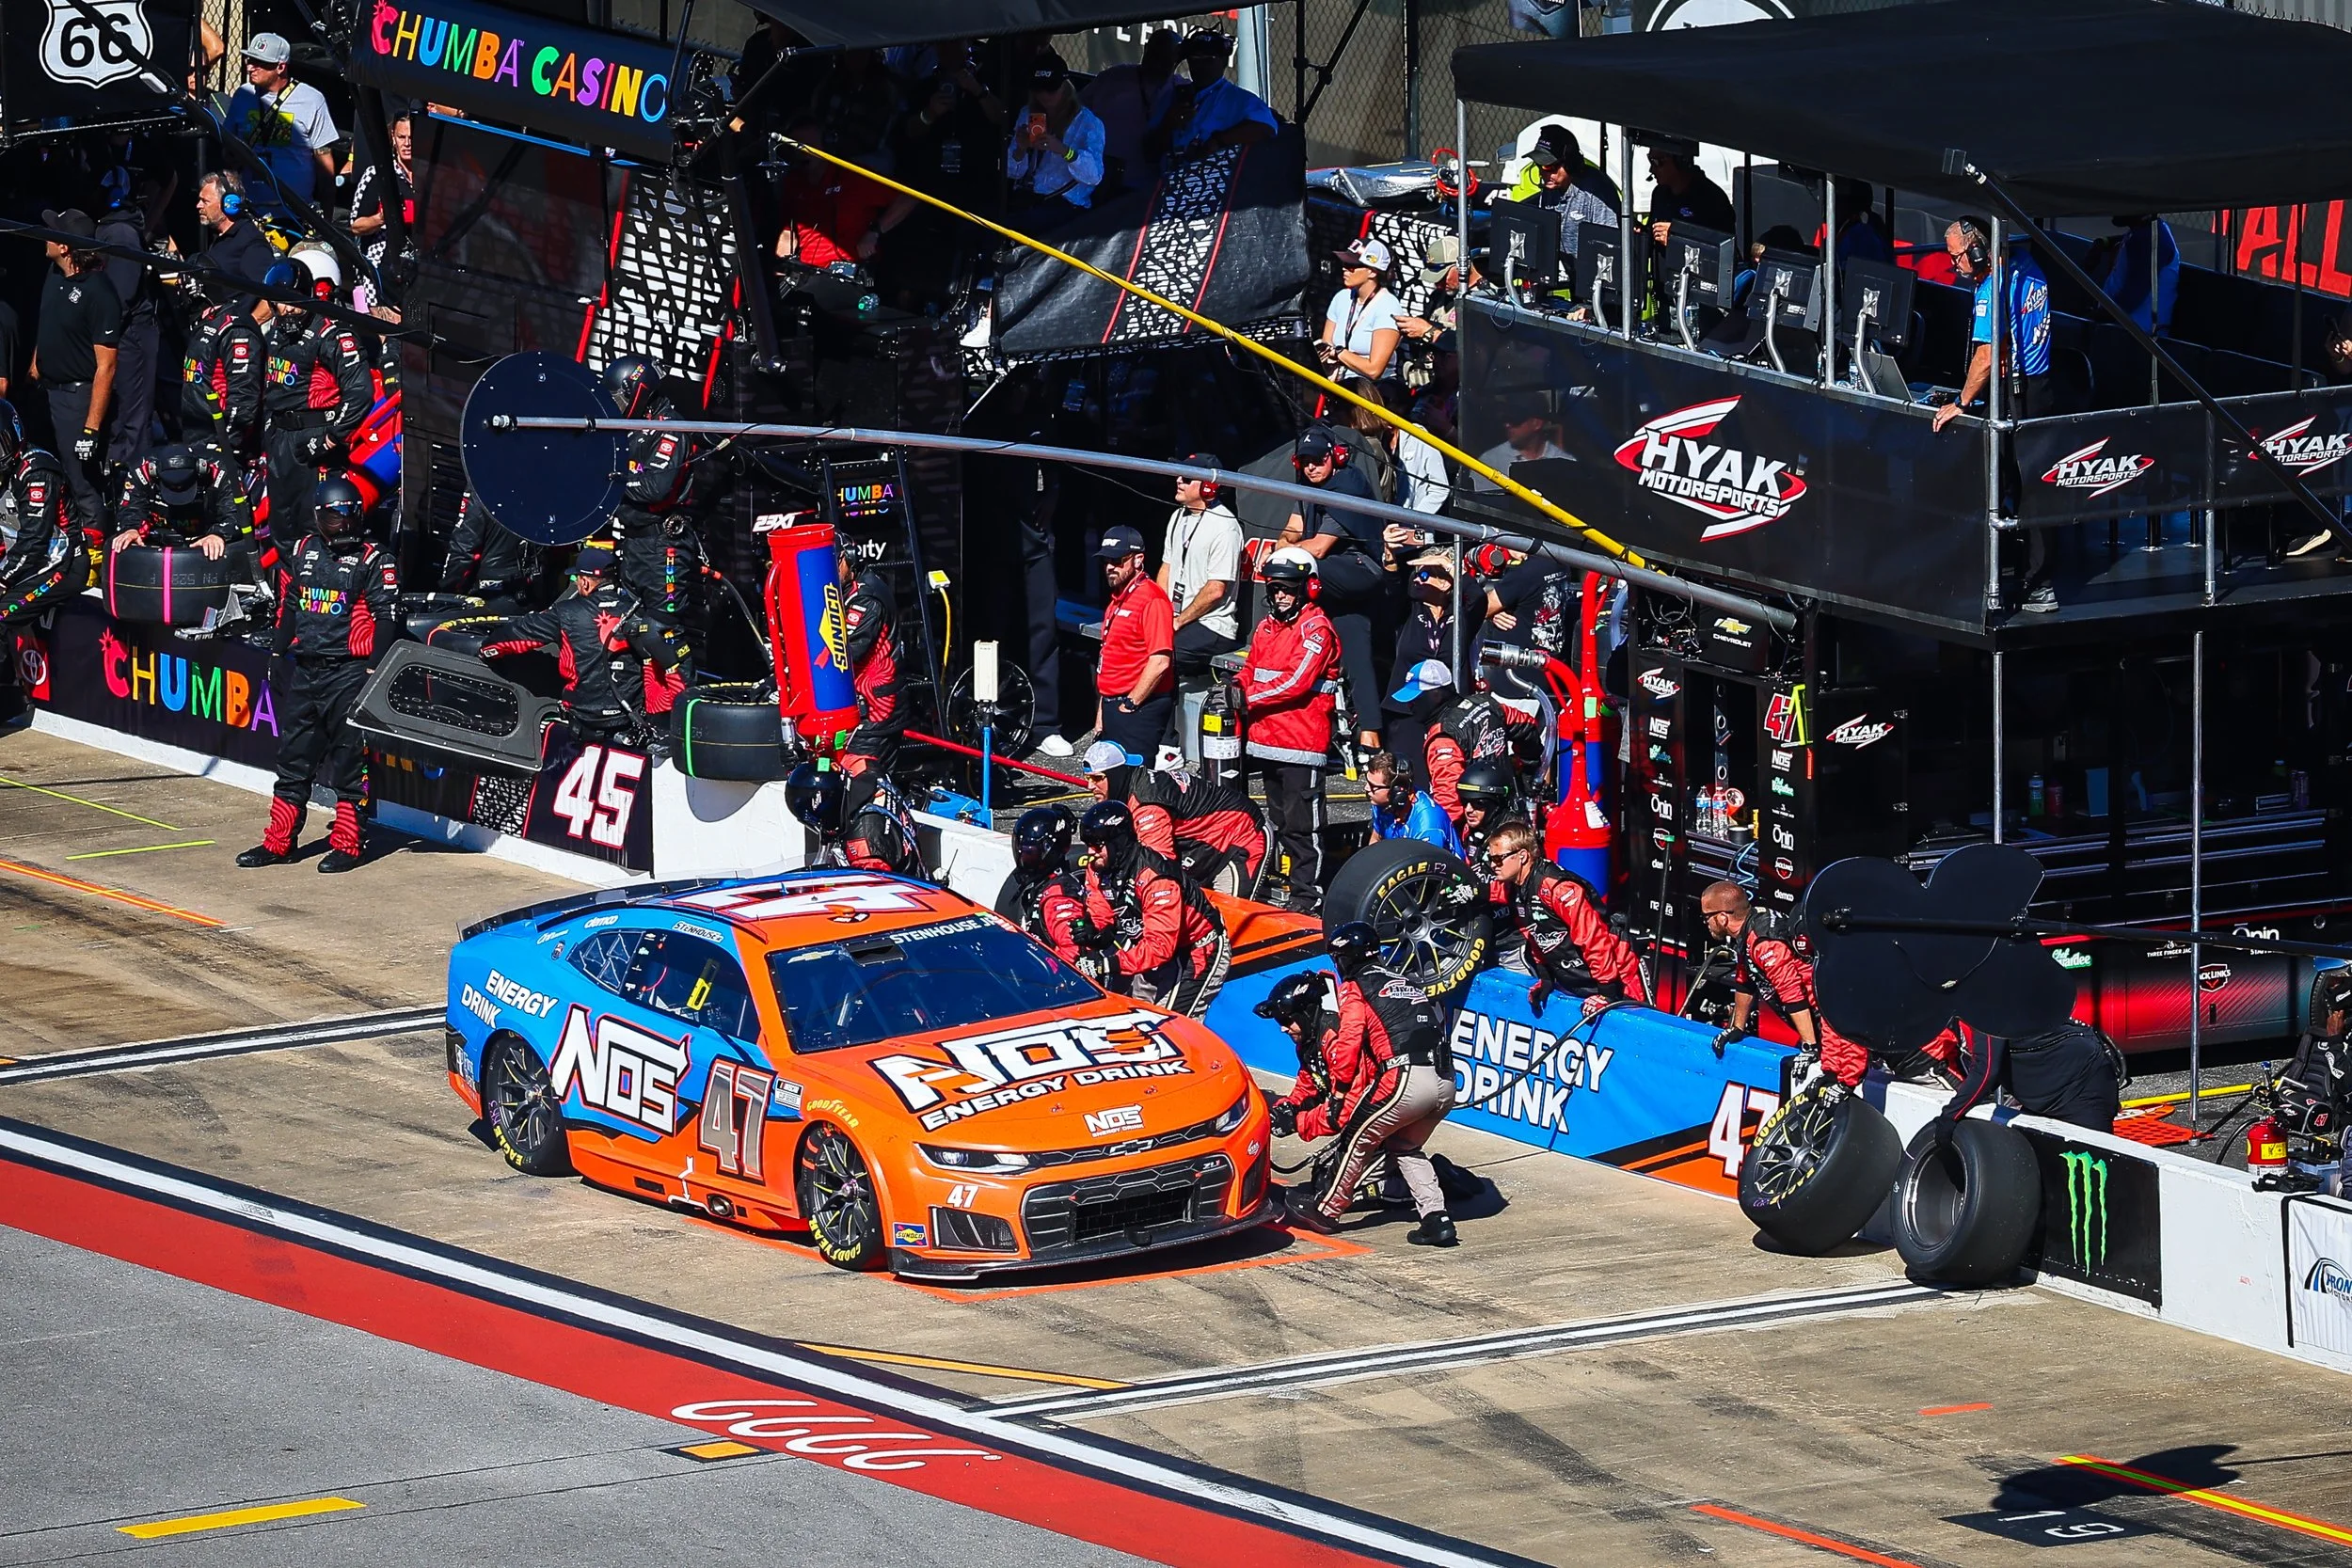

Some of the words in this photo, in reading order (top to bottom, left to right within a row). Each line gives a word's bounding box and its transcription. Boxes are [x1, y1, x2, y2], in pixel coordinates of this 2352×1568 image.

[532, 46, 667, 122] CASINO
[2265, 433, 2351, 456] HYAK
[2275, 449, 2346, 462] TORSPORTS
[1641, 428, 1788, 496] HYAK
[2058, 453, 2141, 480] HYAK
[2057, 468, 2137, 487] MOTORSPORTS
[837, 483, 894, 502] HUMBA
[1638, 468, 1780, 518] MOTORSPORTS
[299, 585, 347, 604] HUMBA
[824, 583, 849, 672] SUNOCO
[1713, 633, 1752, 647] CHEVROLET
[99, 627, 278, 737] CHUMBA
[1644, 674, 1675, 689] HYAK
[1650, 717, 1670, 736] NOS
[1836, 722, 1884, 739] HYAK
[1772, 750, 1793, 768] NOS
[553, 744, 645, 849] 45
[1377, 861, 1428, 899] EAGLE
[1774, 889, 1795, 902] demco
[584, 915, 618, 929] demco
[890, 917, 981, 944] STENHOUSE
[2051, 948, 2069, 959] Chef
[2147, 949, 2163, 958] THREE
[2164, 948, 2182, 958] FINGER
[2183, 947, 2192, 956] JAC
[1426, 937, 1486, 998] GOODYE
[461, 983, 502, 1029] DRINK
[485, 968, 559, 1020] ENERGY
[870, 1008, 1176, 1113] NOS
[1451, 1010, 1613, 1093] ENERGY
[551, 1004, 691, 1137] NOS
[1074, 1059, 1193, 1086] DRINK
[806, 1099, 860, 1129] GOODYEAR
[921, 1075, 1065, 1132] ENERGY
[701, 1059, 773, 1183] 47
[1083, 1103, 1144, 1132] NOS
[1092, 1128, 1121, 1138] ENERGY
[1121, 1123, 1145, 1132] DRINK
[493, 1124, 524, 1166] EAGLE
[946, 1184, 978, 1208] 47
[810, 1215, 862, 1262] GOODYEAR
[895, 1229, 926, 1242] SUNOCO
[2326, 1273, 2352, 1294] FRON
